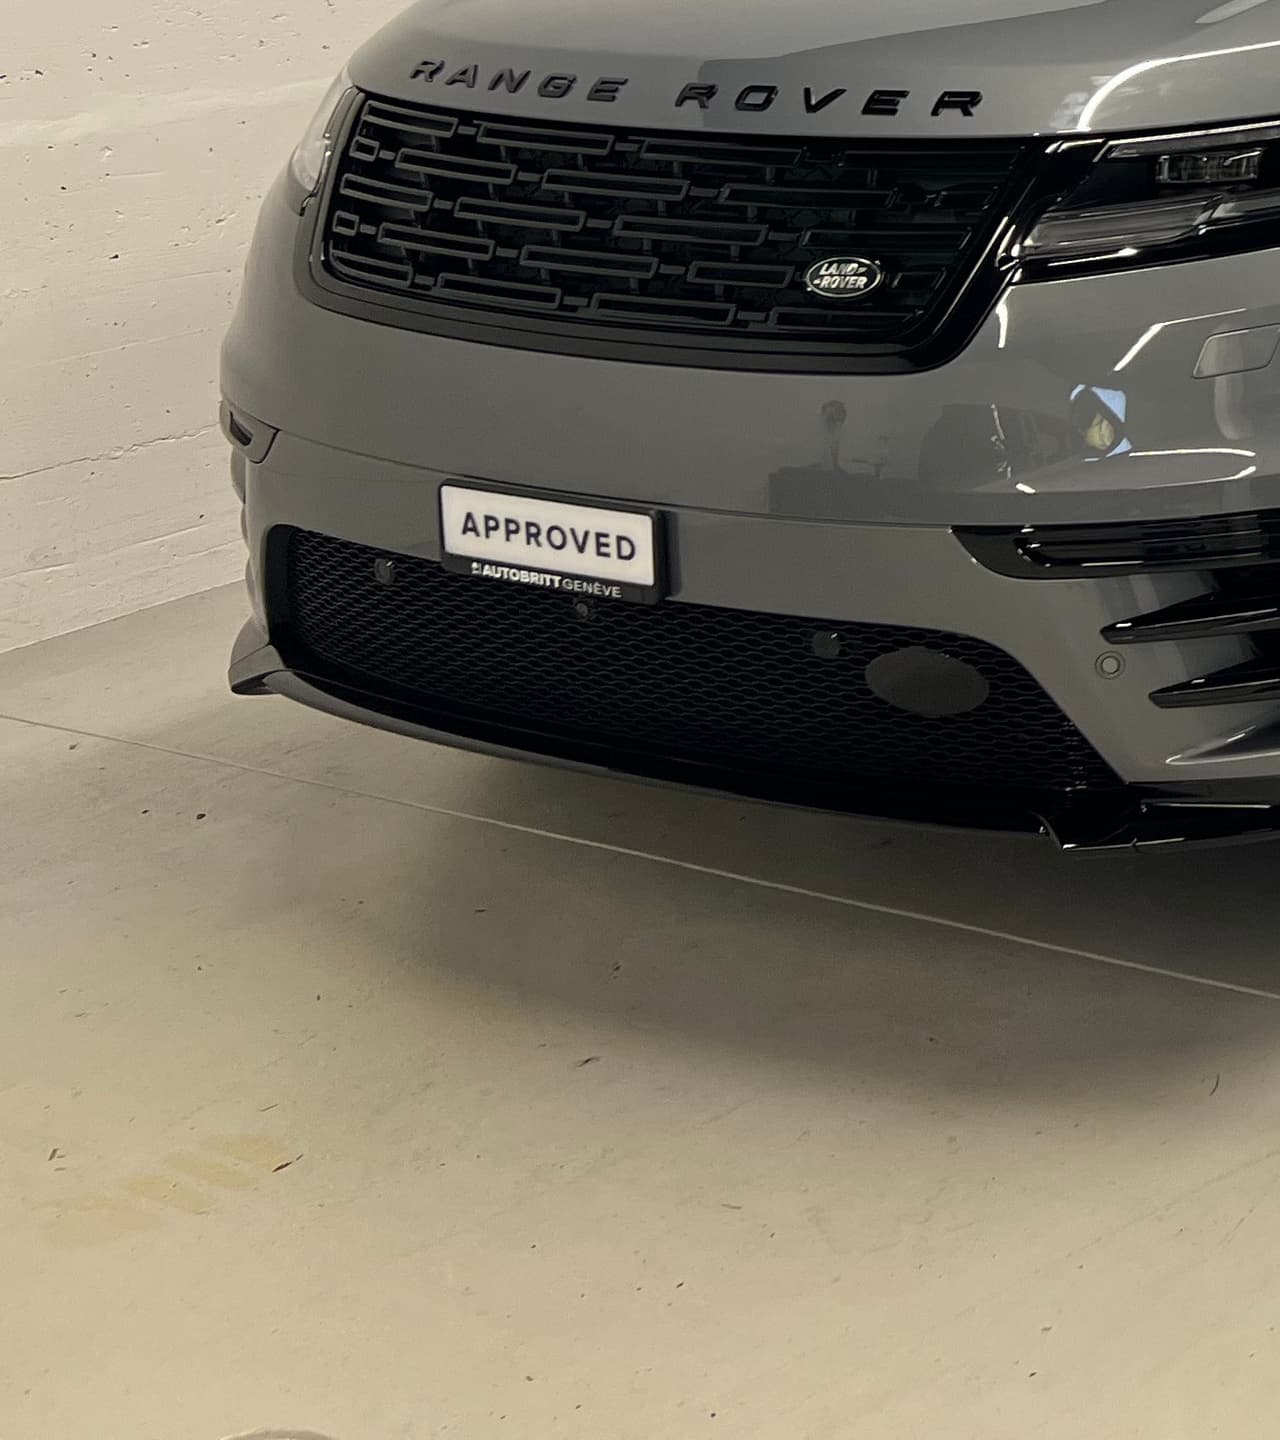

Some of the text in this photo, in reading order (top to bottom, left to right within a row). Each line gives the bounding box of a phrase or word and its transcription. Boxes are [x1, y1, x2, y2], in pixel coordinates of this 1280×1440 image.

[409, 59, 984, 118] RANGE ROVER
[461, 512, 637, 561] APPROVED
[481, 563, 562, 588] AUTOBRITT
